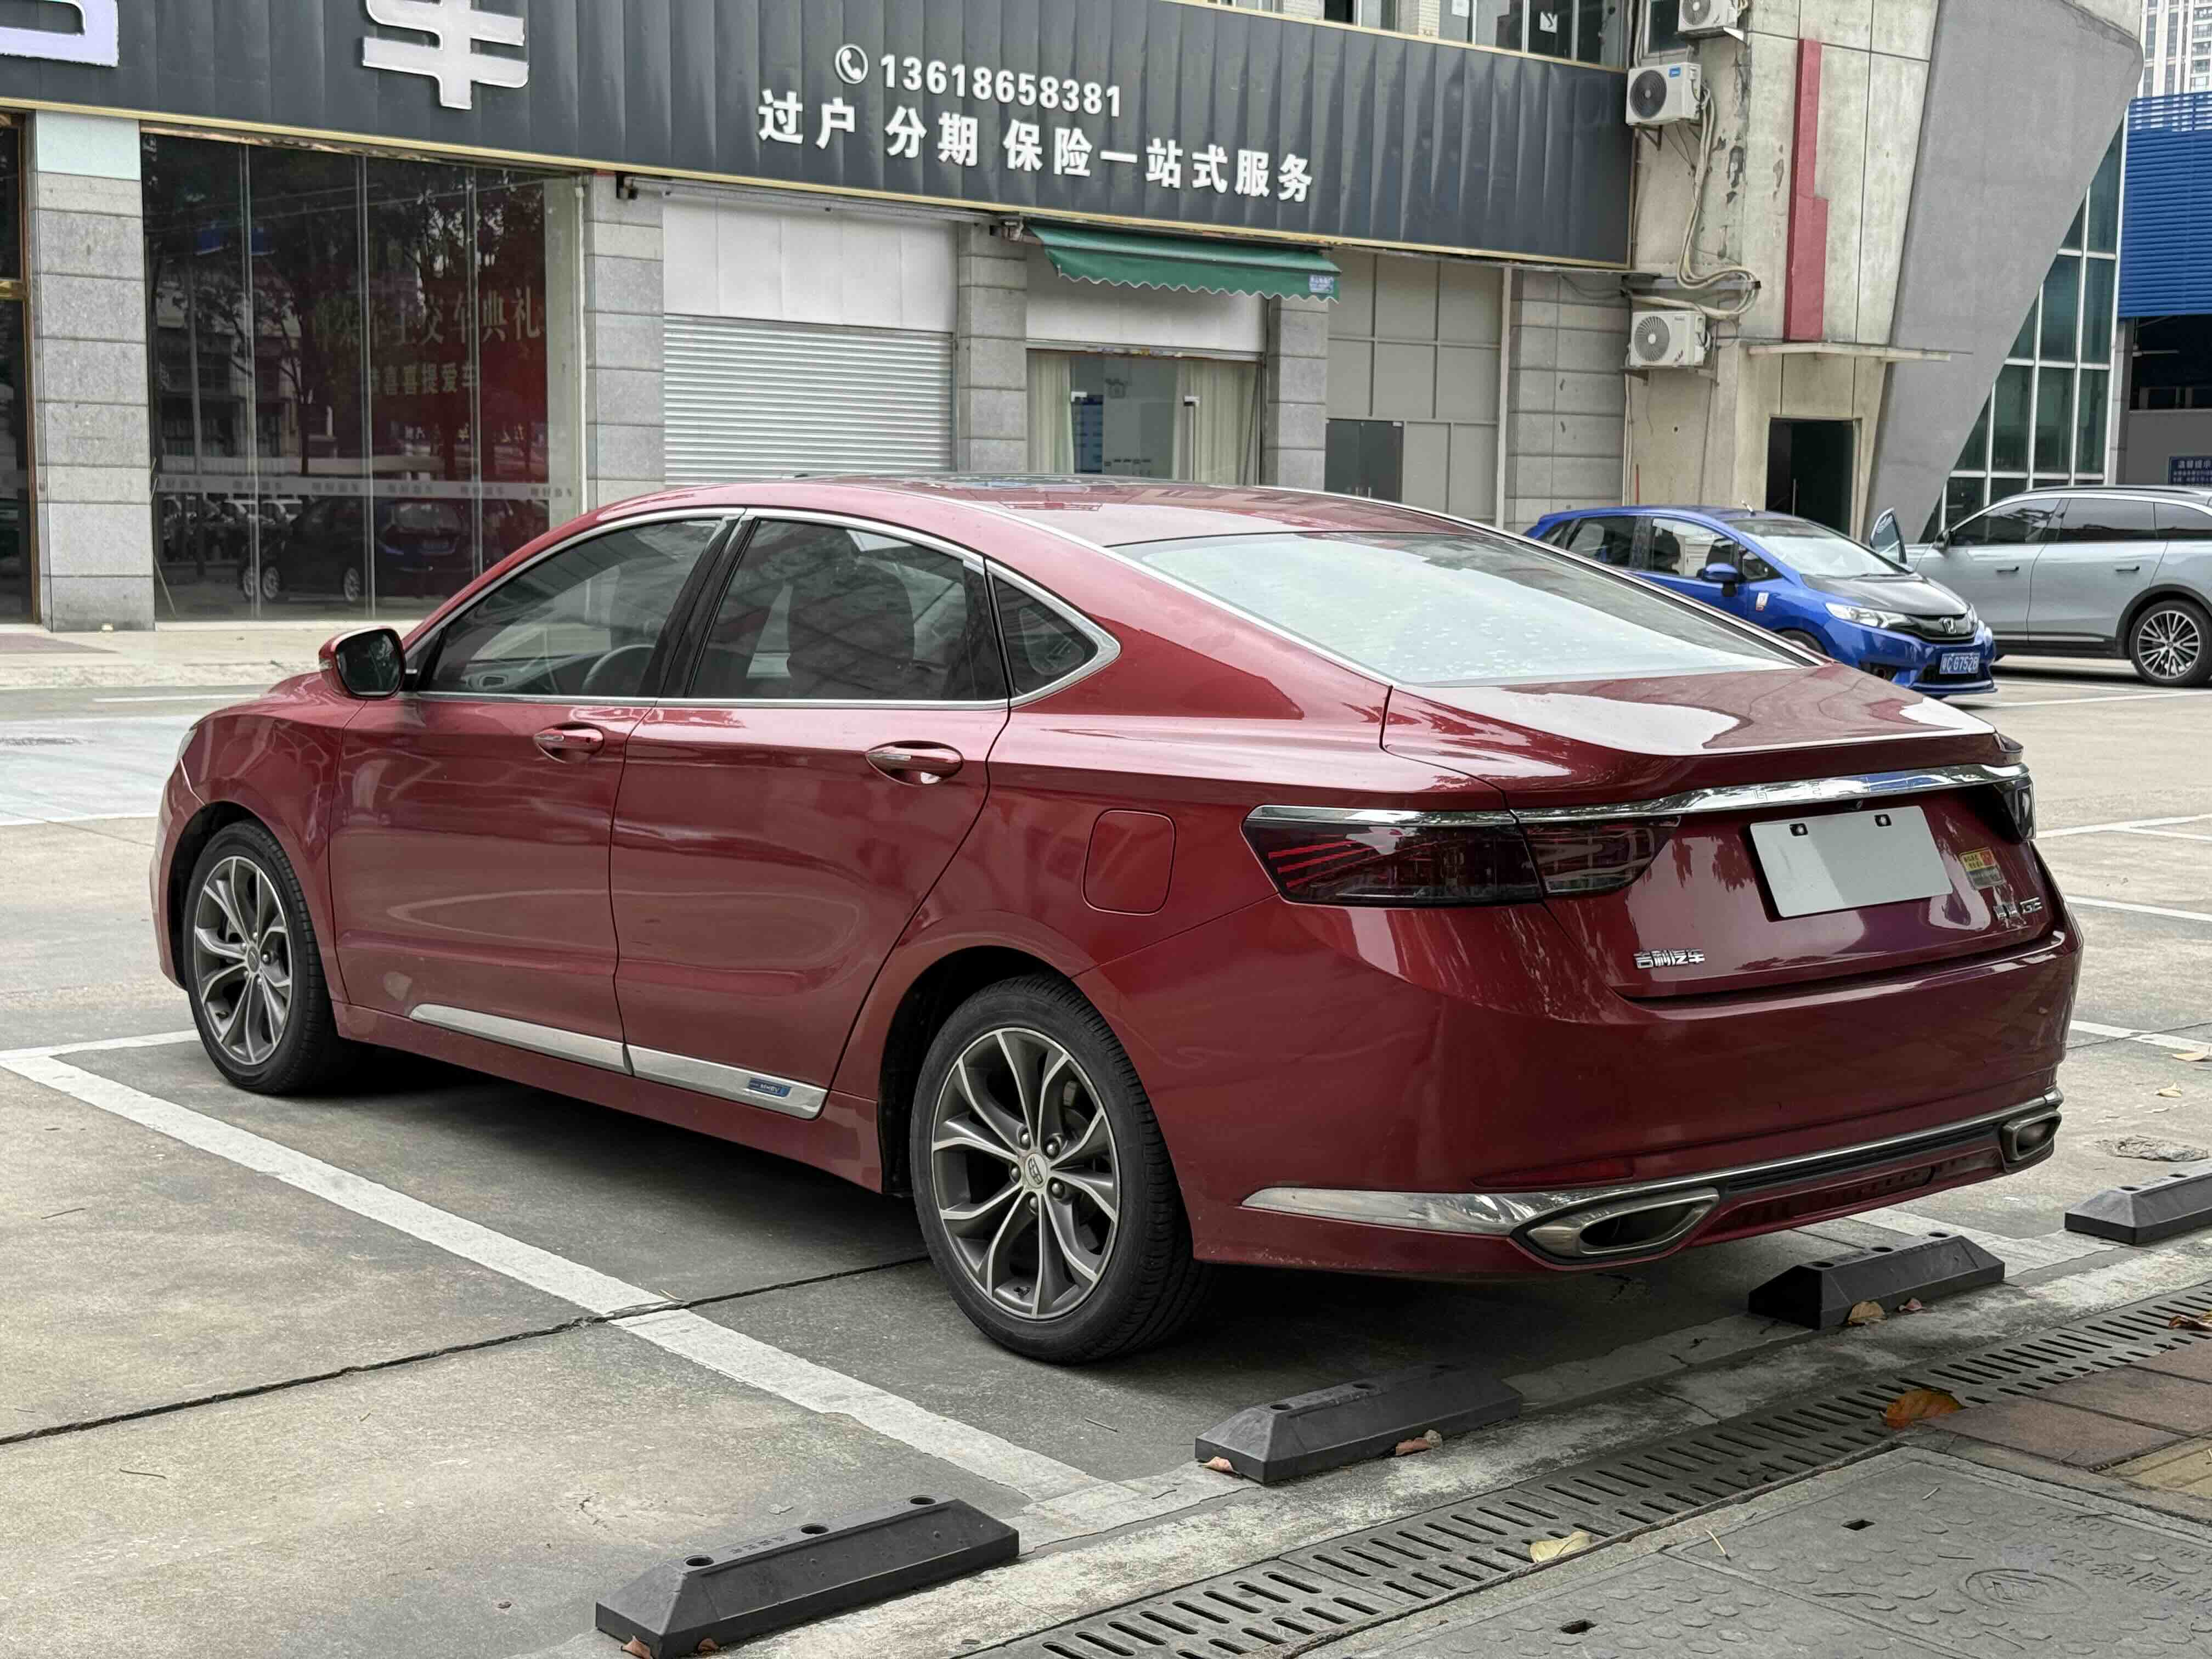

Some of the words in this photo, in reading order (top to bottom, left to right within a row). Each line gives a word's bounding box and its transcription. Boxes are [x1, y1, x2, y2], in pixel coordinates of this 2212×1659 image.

[880, 54, 1120, 117] 13618658381
[758, 88, 856, 149] 过户
[884, 105, 979, 167] 分期
[1002, 119, 1313, 202] 保险一站式服务
[1633, 949, 1705, 969] 吉利汽车
